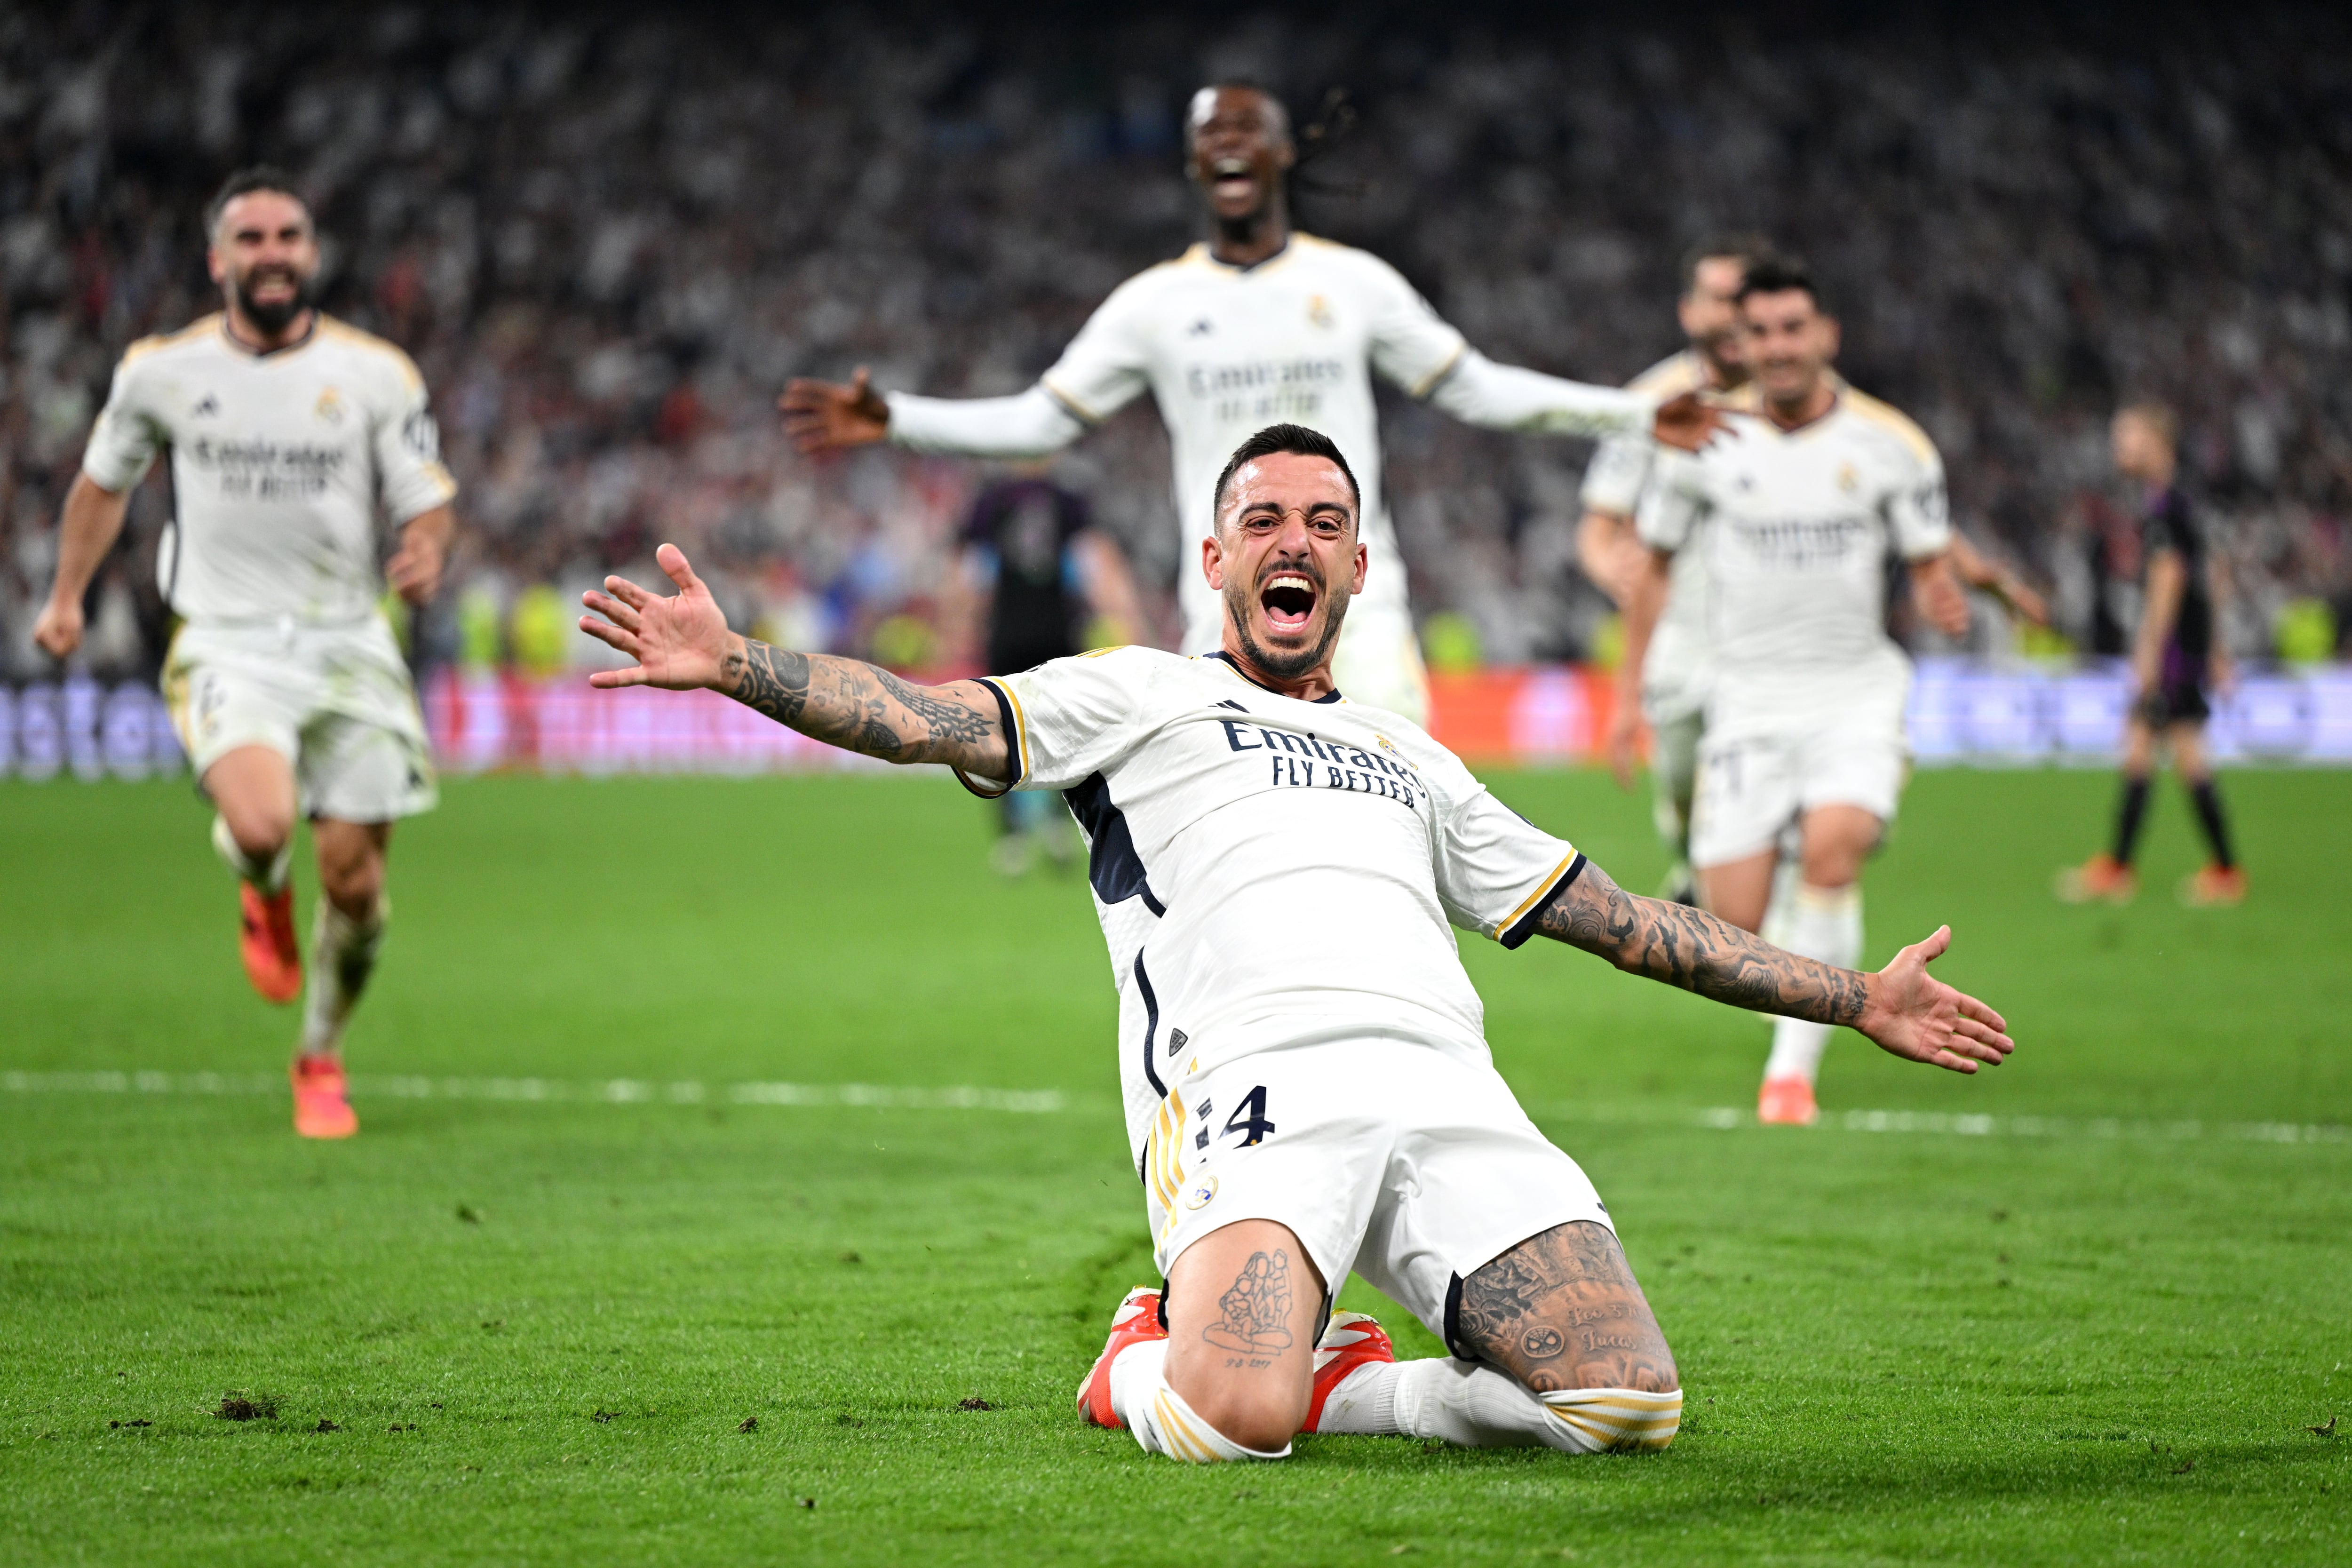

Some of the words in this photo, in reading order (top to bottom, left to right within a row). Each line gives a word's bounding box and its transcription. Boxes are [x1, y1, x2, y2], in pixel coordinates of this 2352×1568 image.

[1218, 720, 1425, 799] Emirates
[1273, 756, 1313, 787] FLY
[1327, 766, 1414, 808] BETTER
[1581, 1330, 1637, 1353] Lucas
